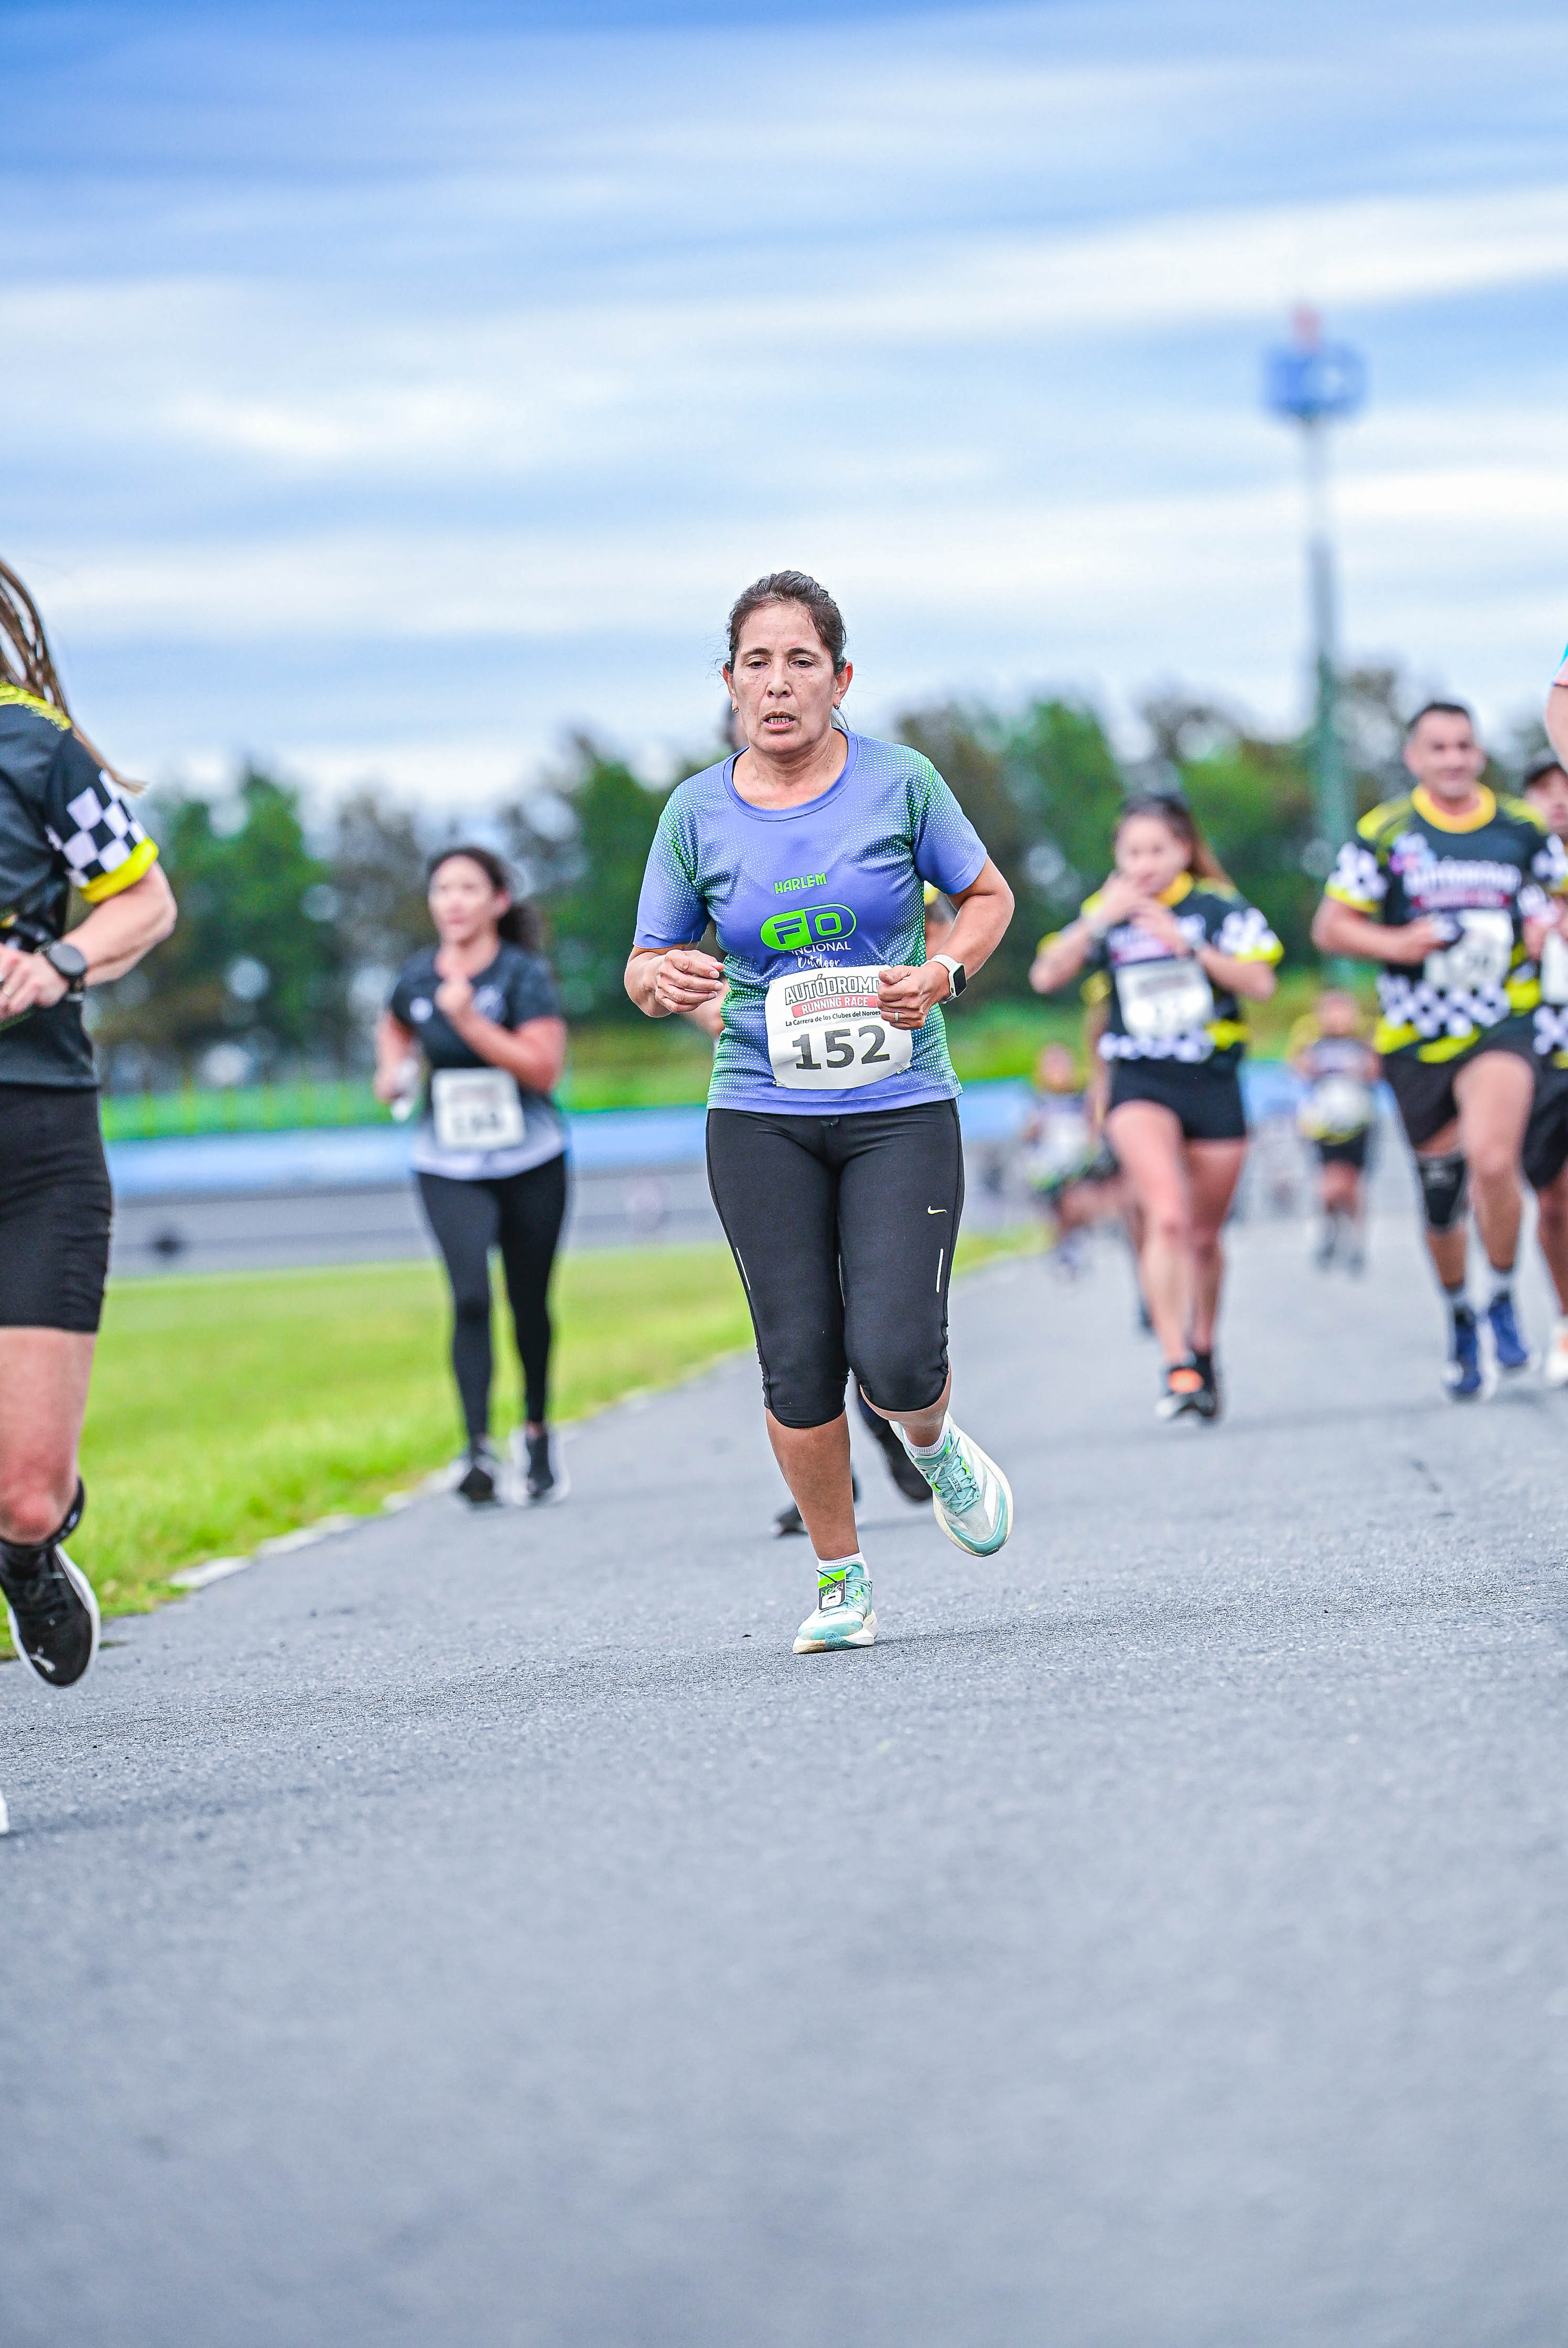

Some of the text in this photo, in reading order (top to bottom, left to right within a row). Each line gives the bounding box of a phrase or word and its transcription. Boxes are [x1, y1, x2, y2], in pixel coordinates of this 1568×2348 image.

[774, 872, 827, 895] HARLEM
[797, 954, 840, 969] Outdoor
[801, 996, 868, 1015] RUNNING RACE
[792, 1025, 890, 1070] 152
